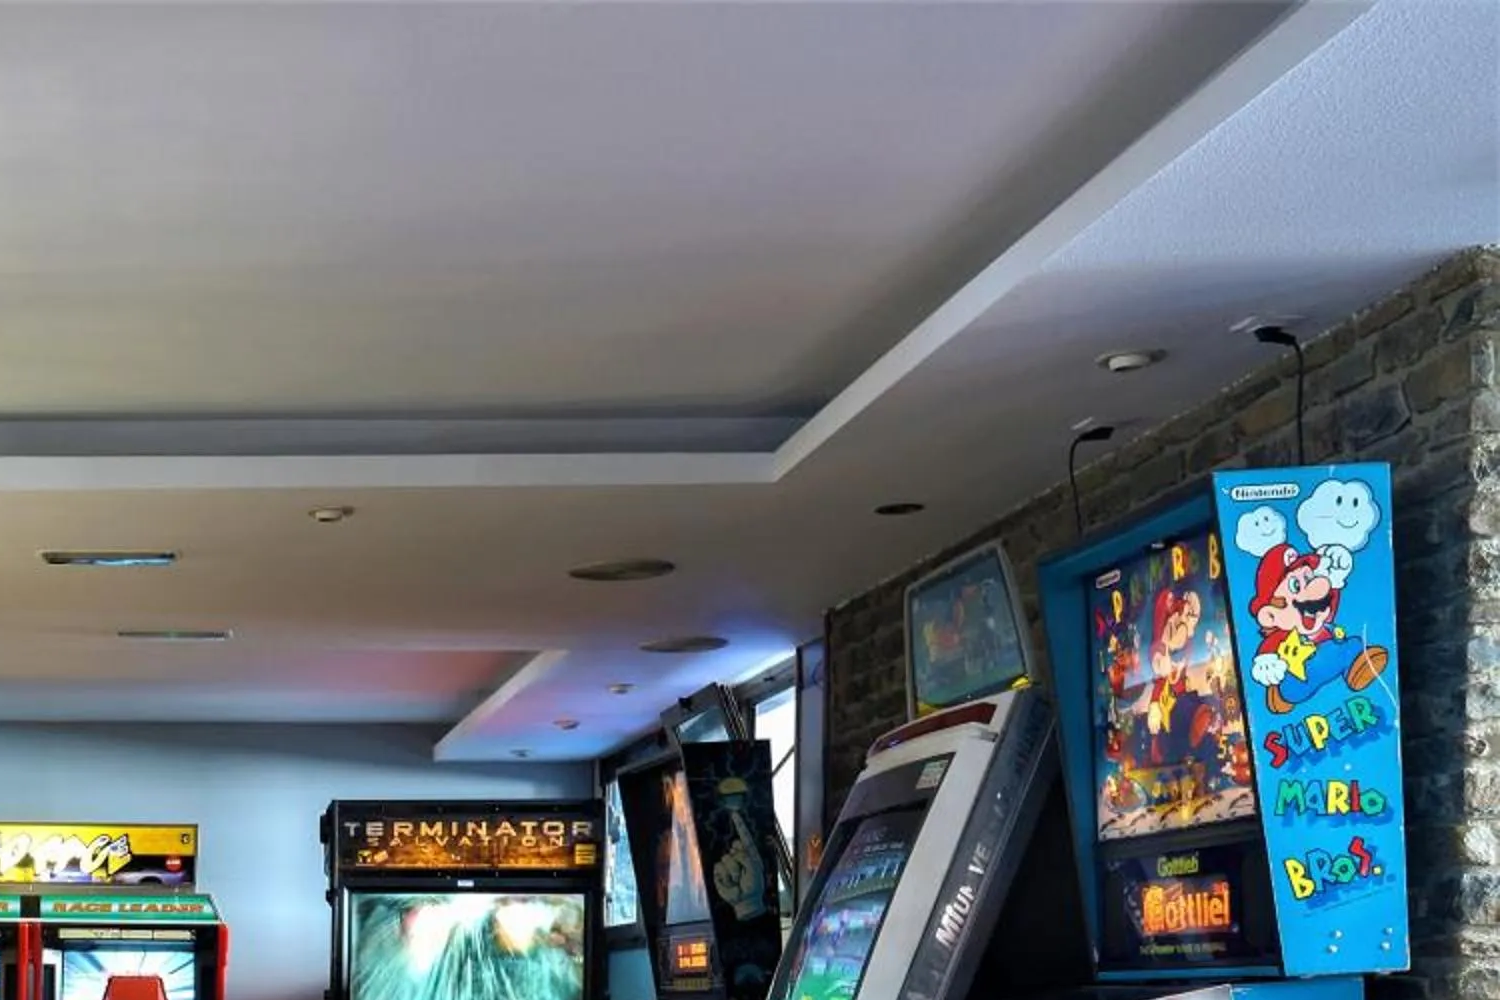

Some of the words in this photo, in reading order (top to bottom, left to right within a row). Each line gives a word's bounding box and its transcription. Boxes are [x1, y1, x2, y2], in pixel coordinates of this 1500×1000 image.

[1263, 695, 1380, 768] SUPER
[1274, 778, 1387, 816] MARIO
[344, 820, 593, 837] TERMINATOR
[366, 835, 564, 848] SALVATION
[1283, 836, 1384, 901] BROS.
[53, 903, 112, 912] RACE
[118, 903, 204, 913] LEADER
